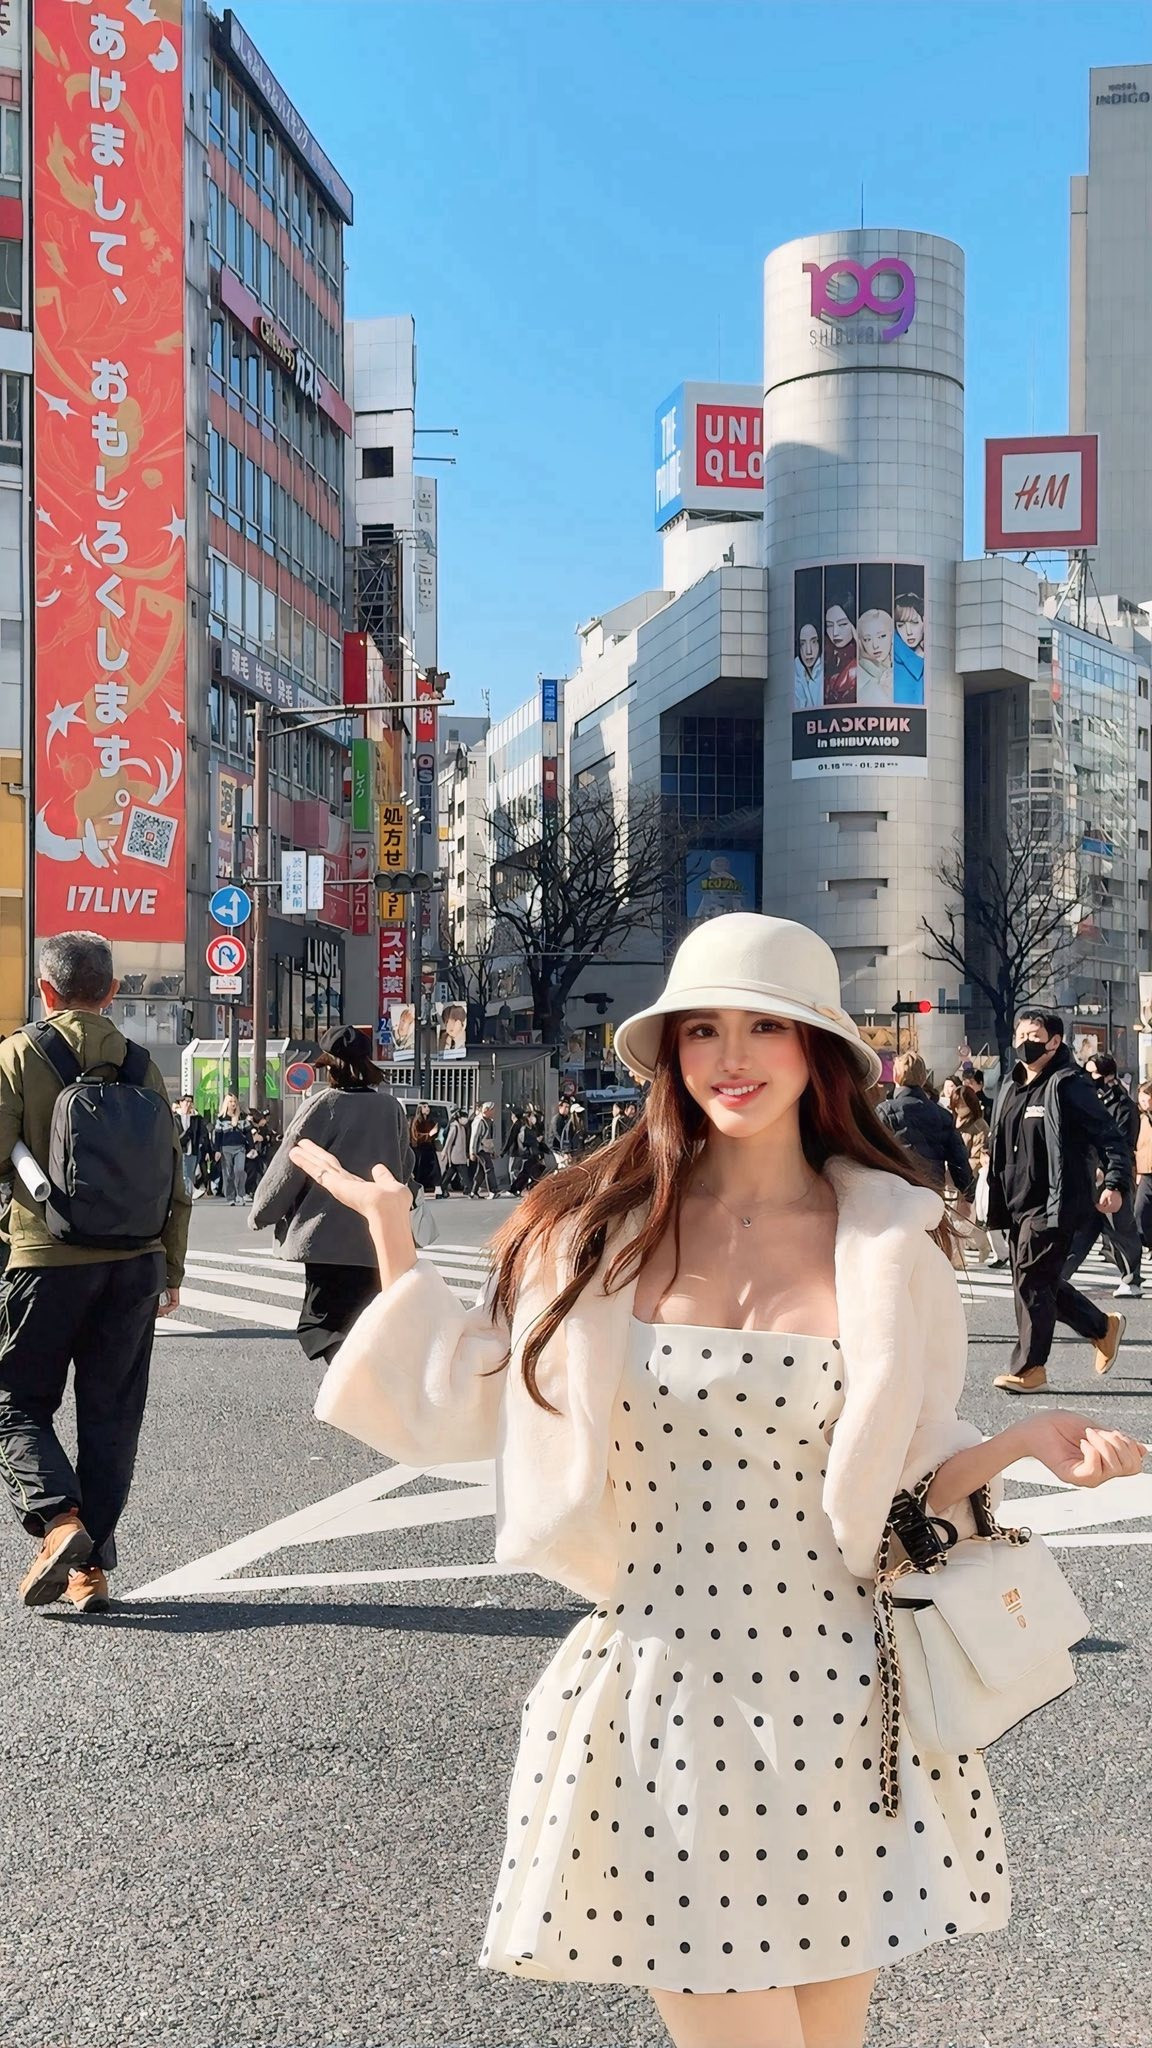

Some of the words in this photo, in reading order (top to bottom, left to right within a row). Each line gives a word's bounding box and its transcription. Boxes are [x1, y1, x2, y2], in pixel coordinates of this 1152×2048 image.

[1095, 91, 1151, 106] INDIGO
[89, 12, 127, 306] あけまして、
[802, 257, 916, 344] 109
[705, 414, 761, 446] UNI
[1015, 472, 1070, 511] H&M
[92, 357, 130, 808] おもしろくします。
[829, 736, 900, 748] SHIBUYA109
[355, 769, 366, 799] レイク
[307, 936, 341, 978] LUSH
